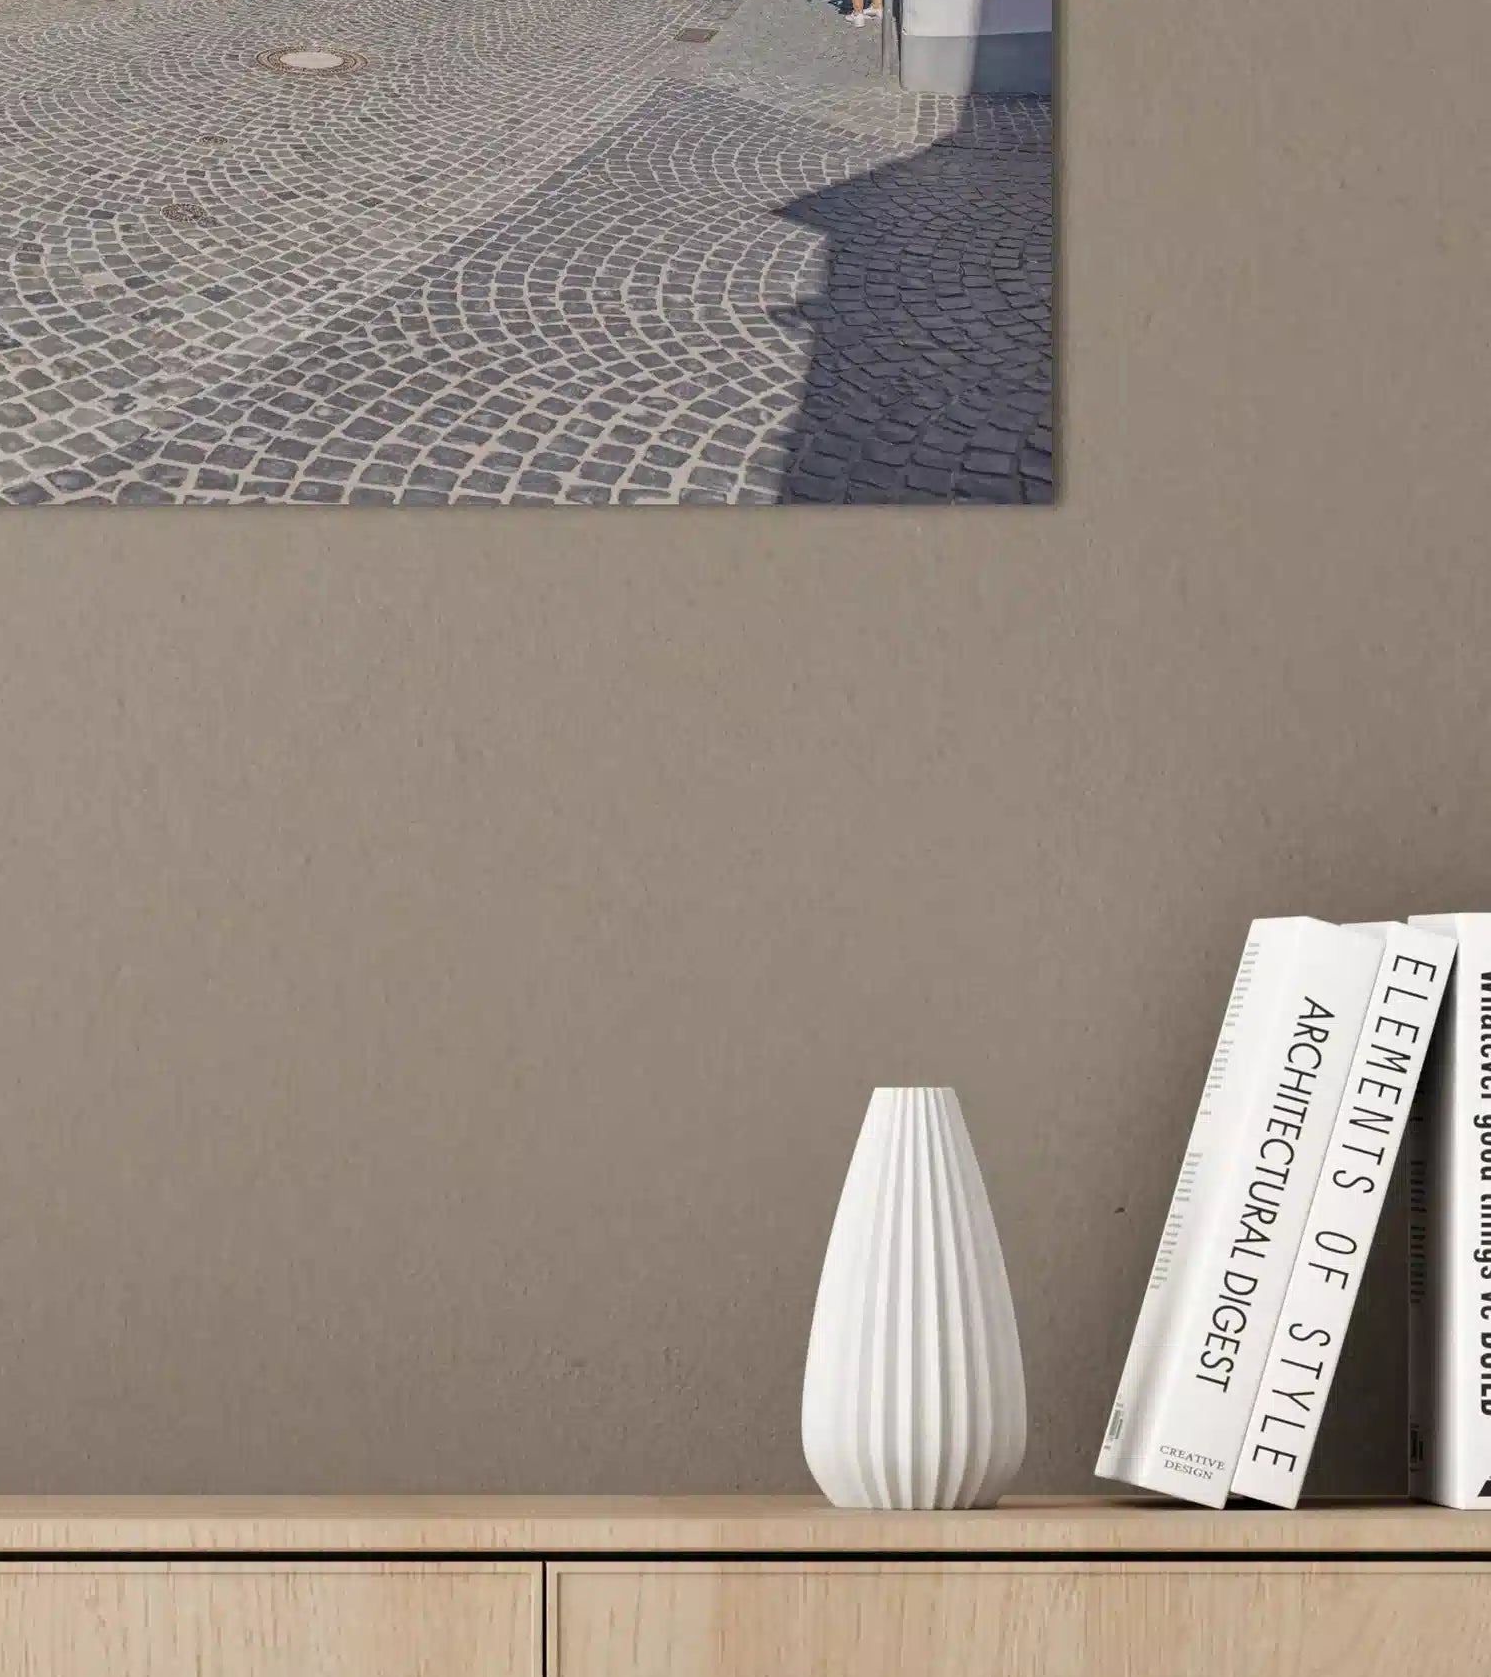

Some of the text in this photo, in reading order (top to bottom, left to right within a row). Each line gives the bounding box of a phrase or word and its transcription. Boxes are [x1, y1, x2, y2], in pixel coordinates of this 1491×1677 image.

[1195, 996, 1336, 1393] ARCHITECTURAL DIGEST
[1252, 954, 1437, 1474] ELEMENTS OF STYLE
[1159, 1444, 1225, 1471] CREATIVE
[1164, 1458, 1213, 1480] DESIGN
